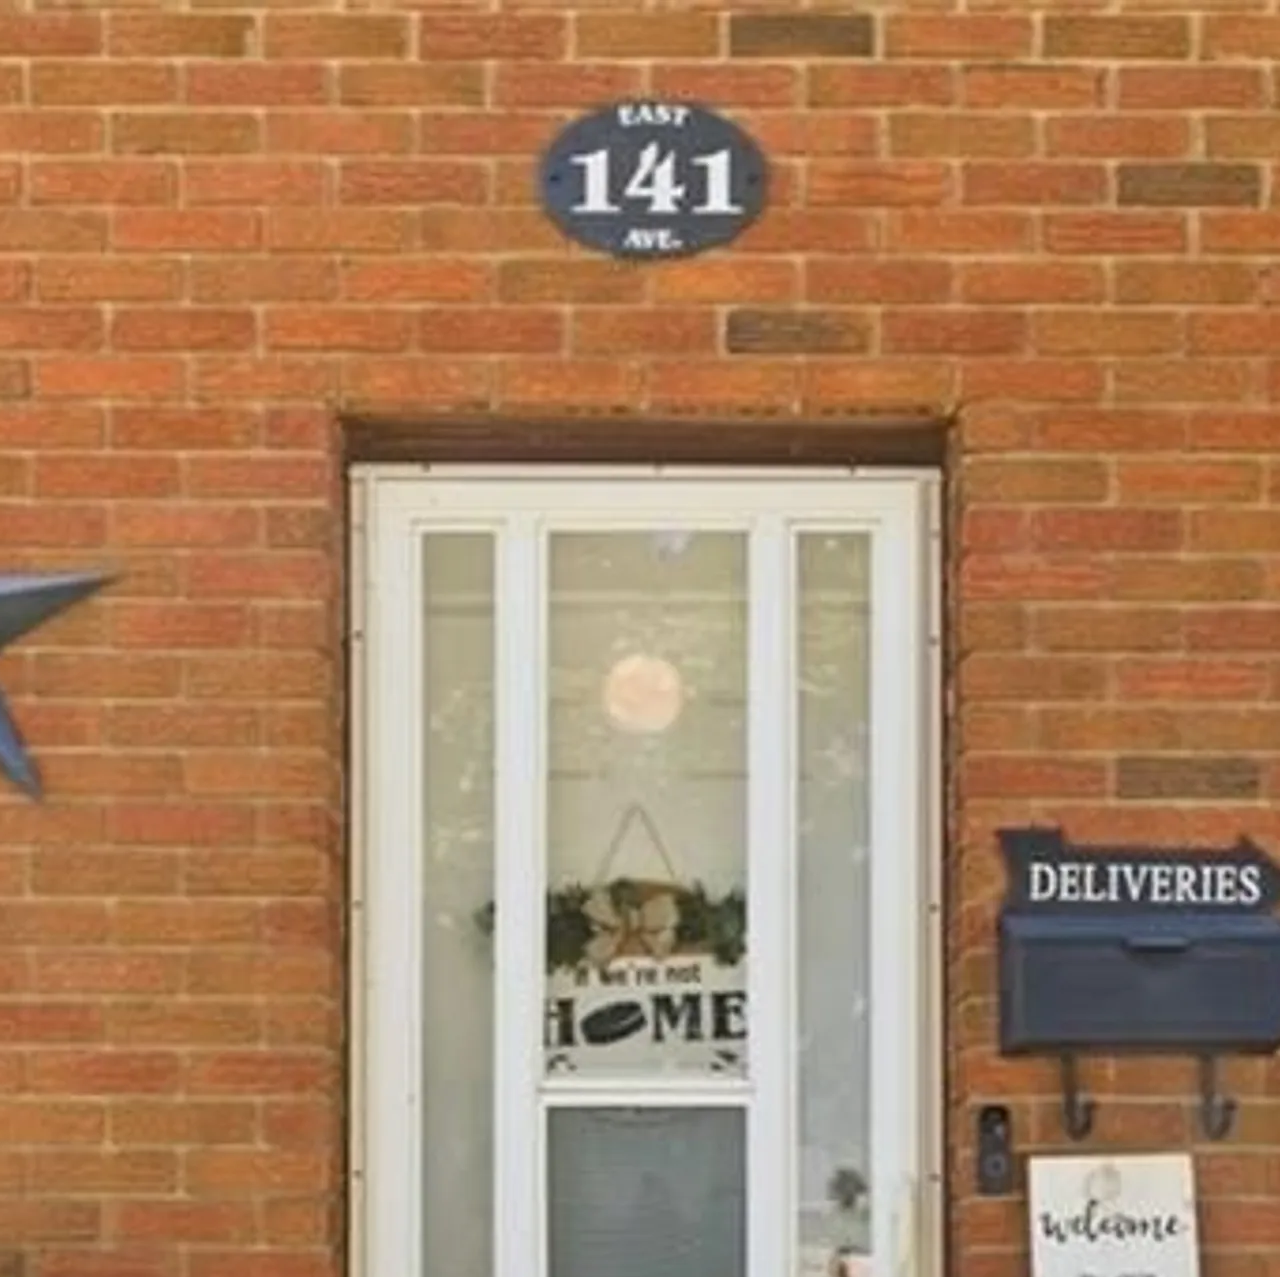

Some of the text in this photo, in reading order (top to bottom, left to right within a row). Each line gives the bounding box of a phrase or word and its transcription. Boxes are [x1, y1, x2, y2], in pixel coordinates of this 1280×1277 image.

[618, 104, 691, 127] EAST
[569, 142, 744, 214] 141
[623, 228, 683, 250] AVE.
[1029, 862, 1262, 904] DELIVERIES
[664, 963, 701, 984] not
[545, 991, 747, 1047] HME
[1039, 1199, 1189, 1243] welcome
